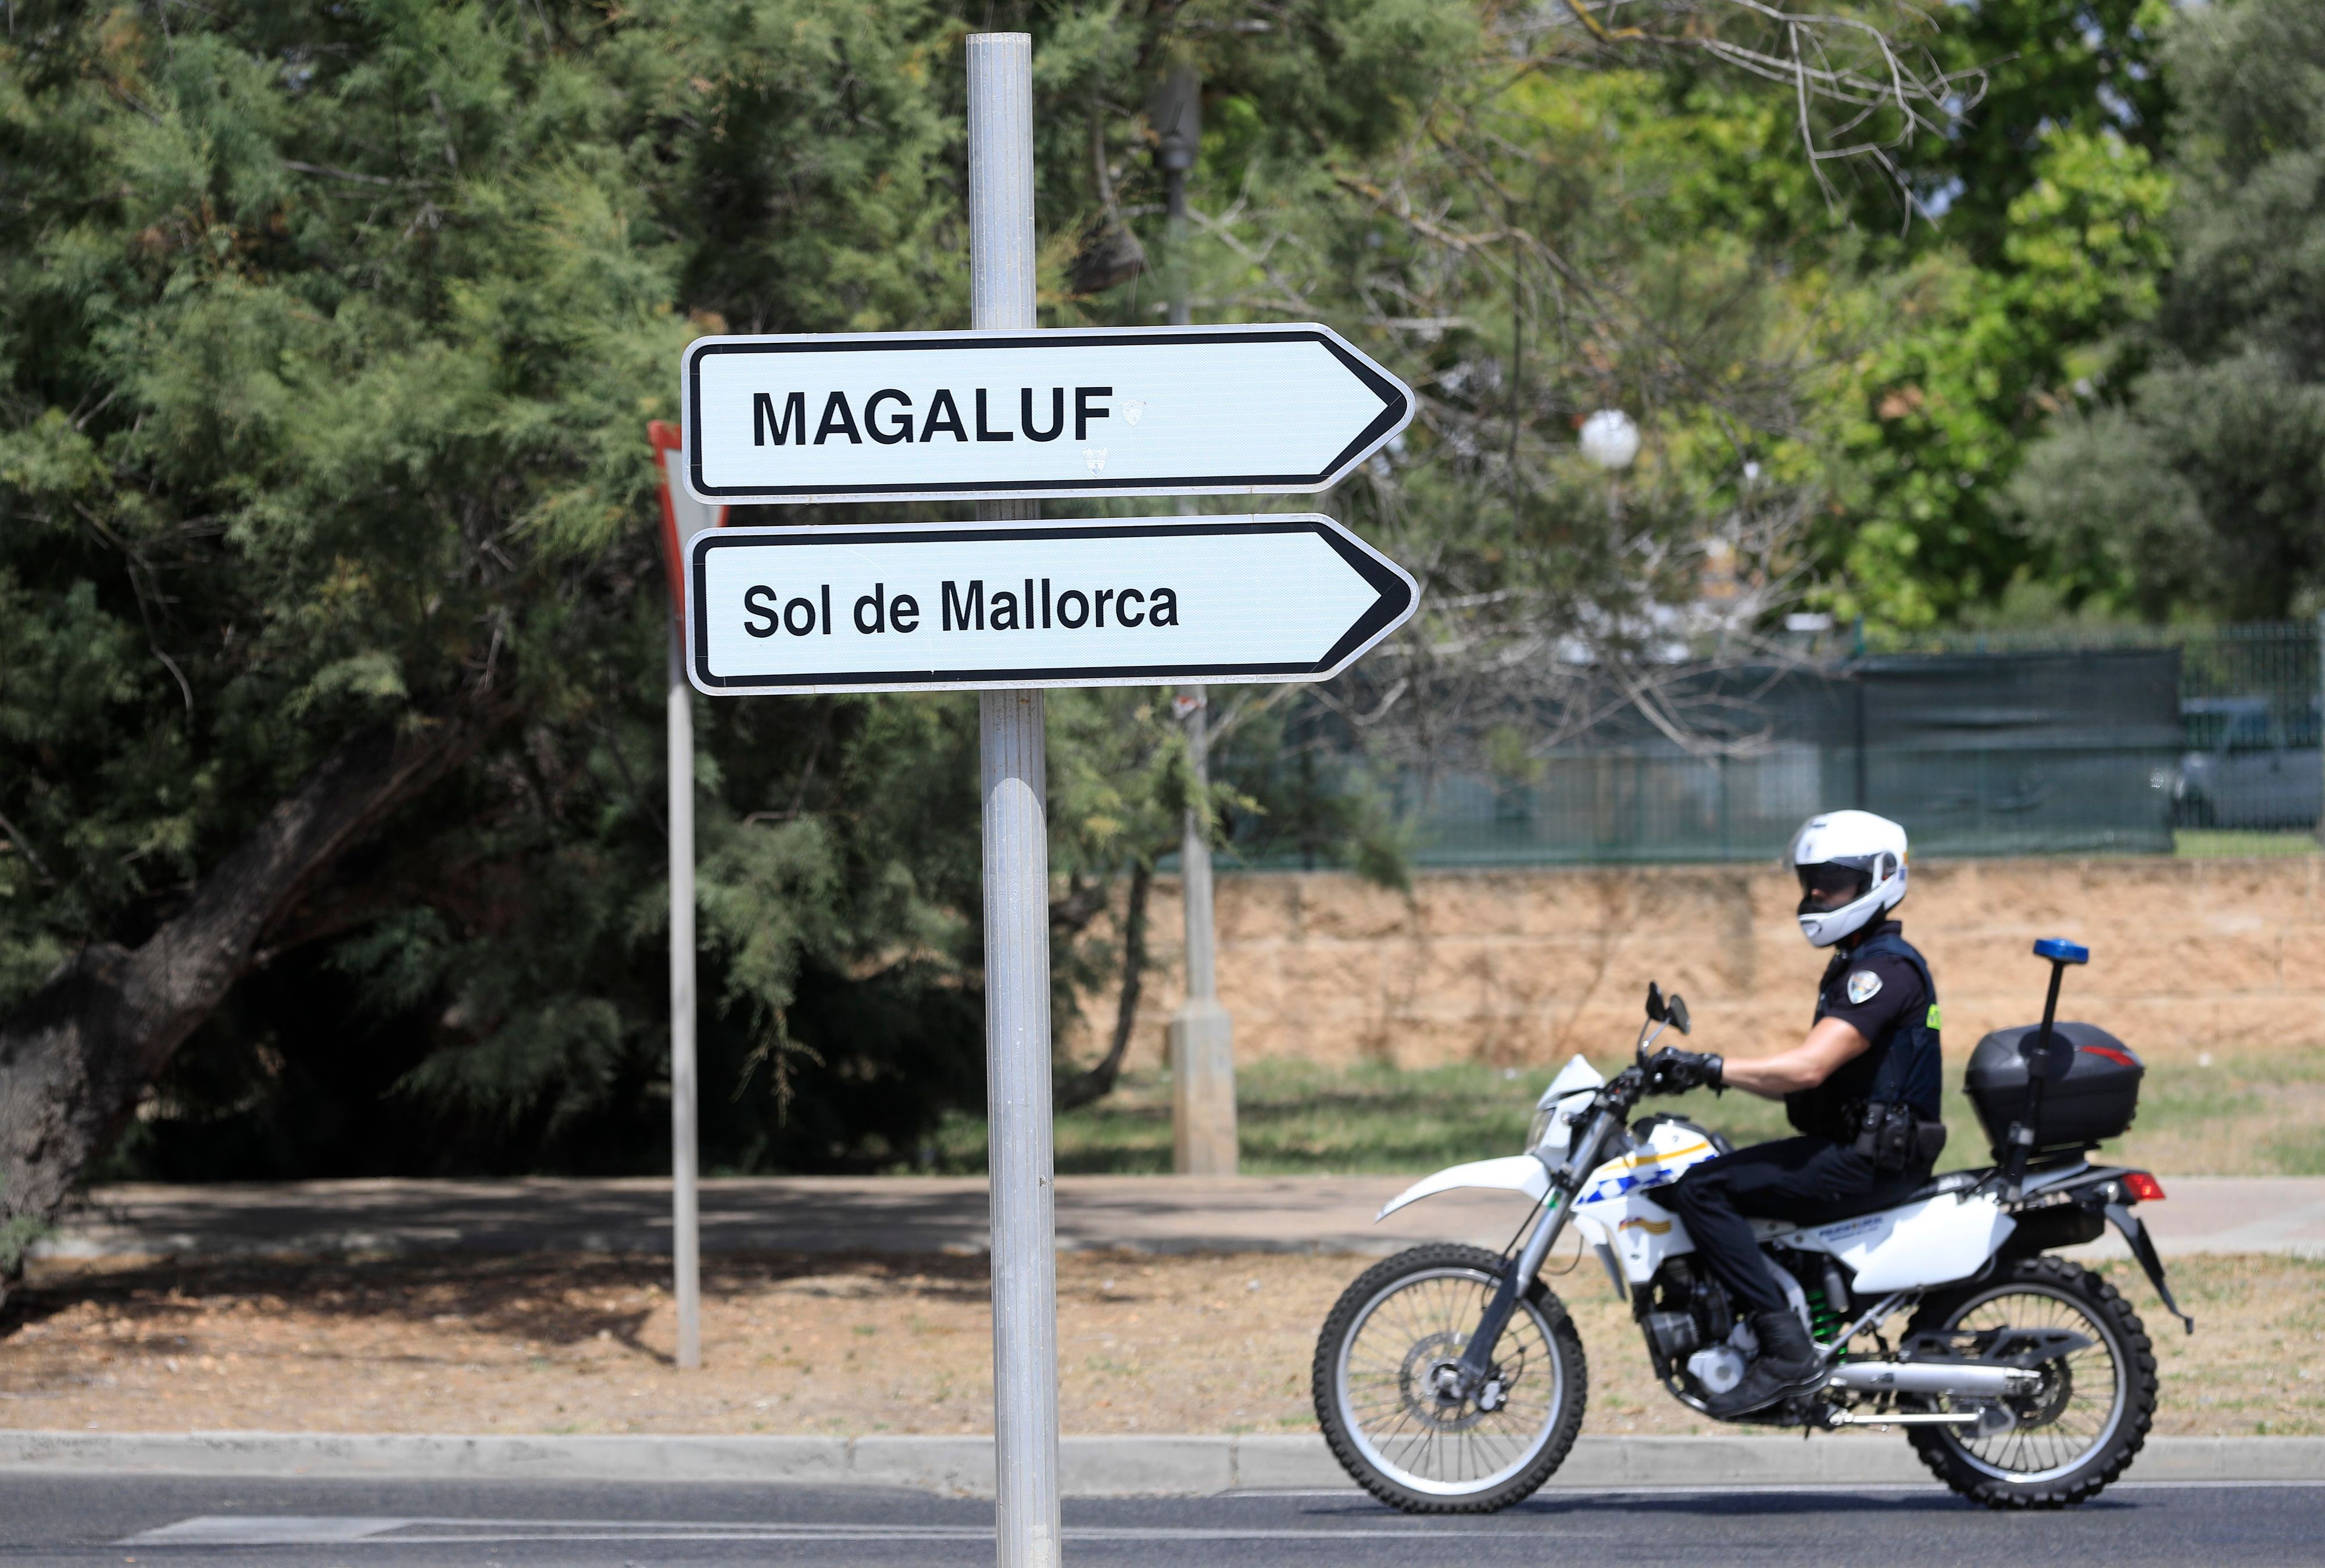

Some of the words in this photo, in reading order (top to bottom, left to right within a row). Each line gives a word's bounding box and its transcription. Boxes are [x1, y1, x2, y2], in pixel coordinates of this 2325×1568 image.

[754, 387, 1113, 446] MAGALUF
[745, 583, 831, 638] Sol
[854, 583, 920, 635] de
[942, 578, 1179, 631] Mallorca
